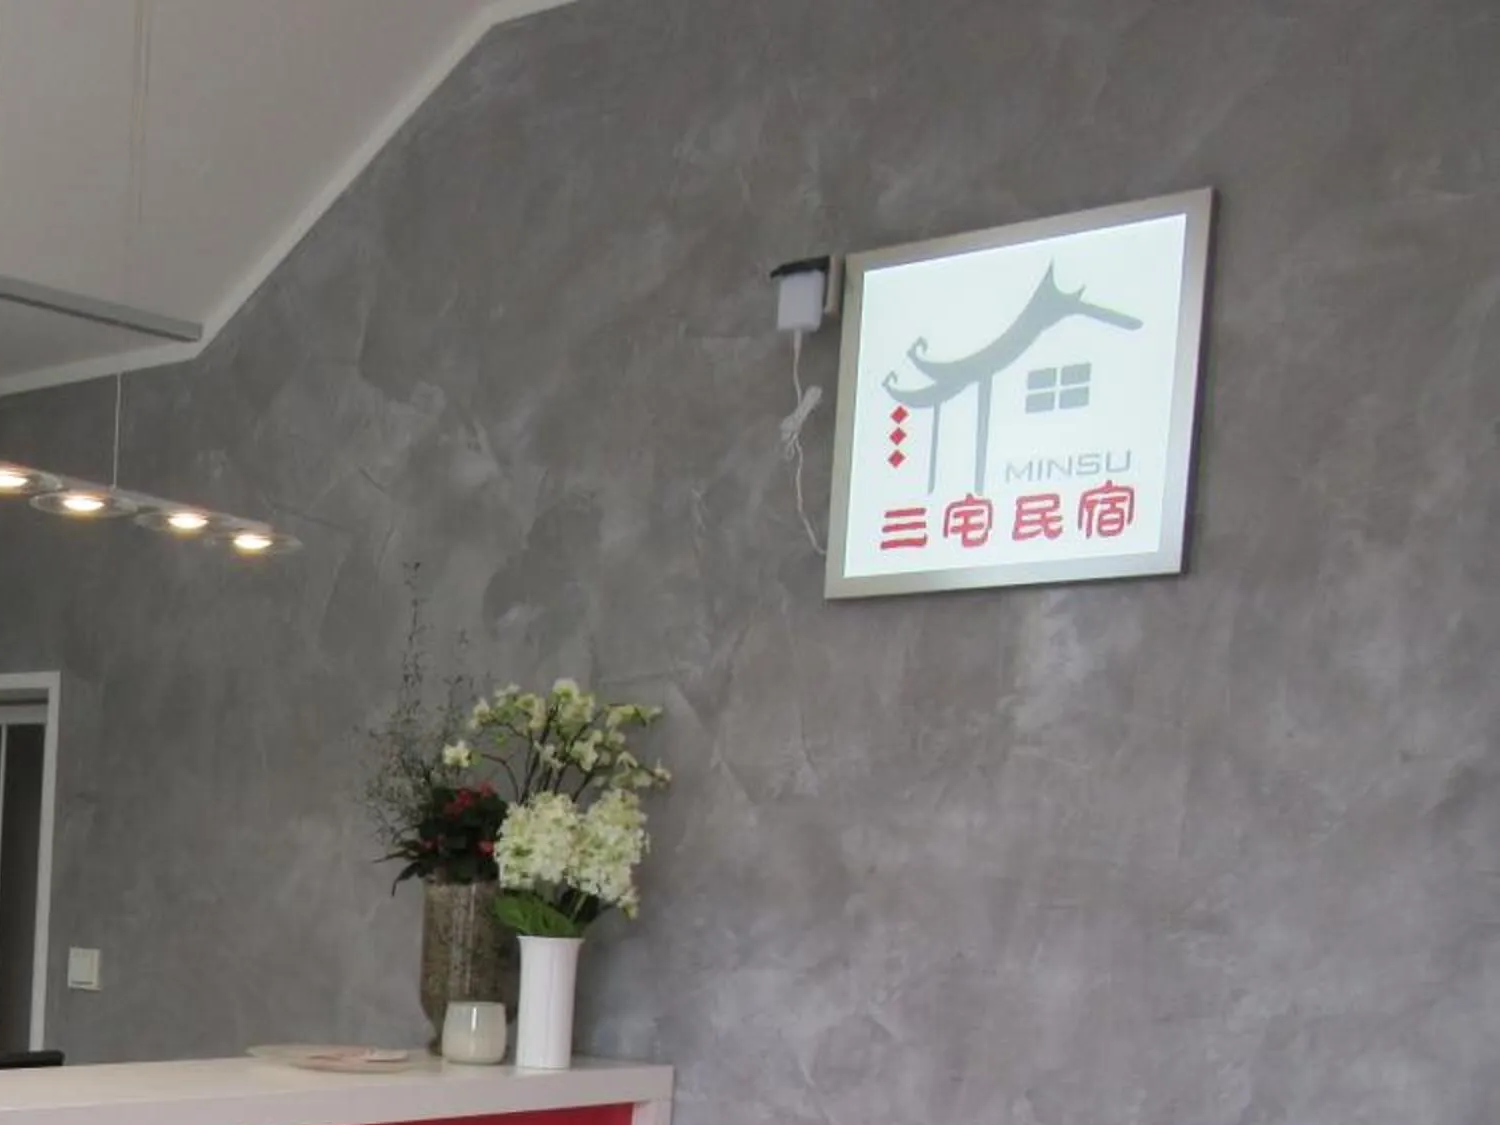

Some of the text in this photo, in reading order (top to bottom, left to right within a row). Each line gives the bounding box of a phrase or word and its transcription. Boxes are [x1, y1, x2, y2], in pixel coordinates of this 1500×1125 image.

[1005, 450, 1132, 484] MINSU
[880, 481, 1135, 549] 三宅民宿
